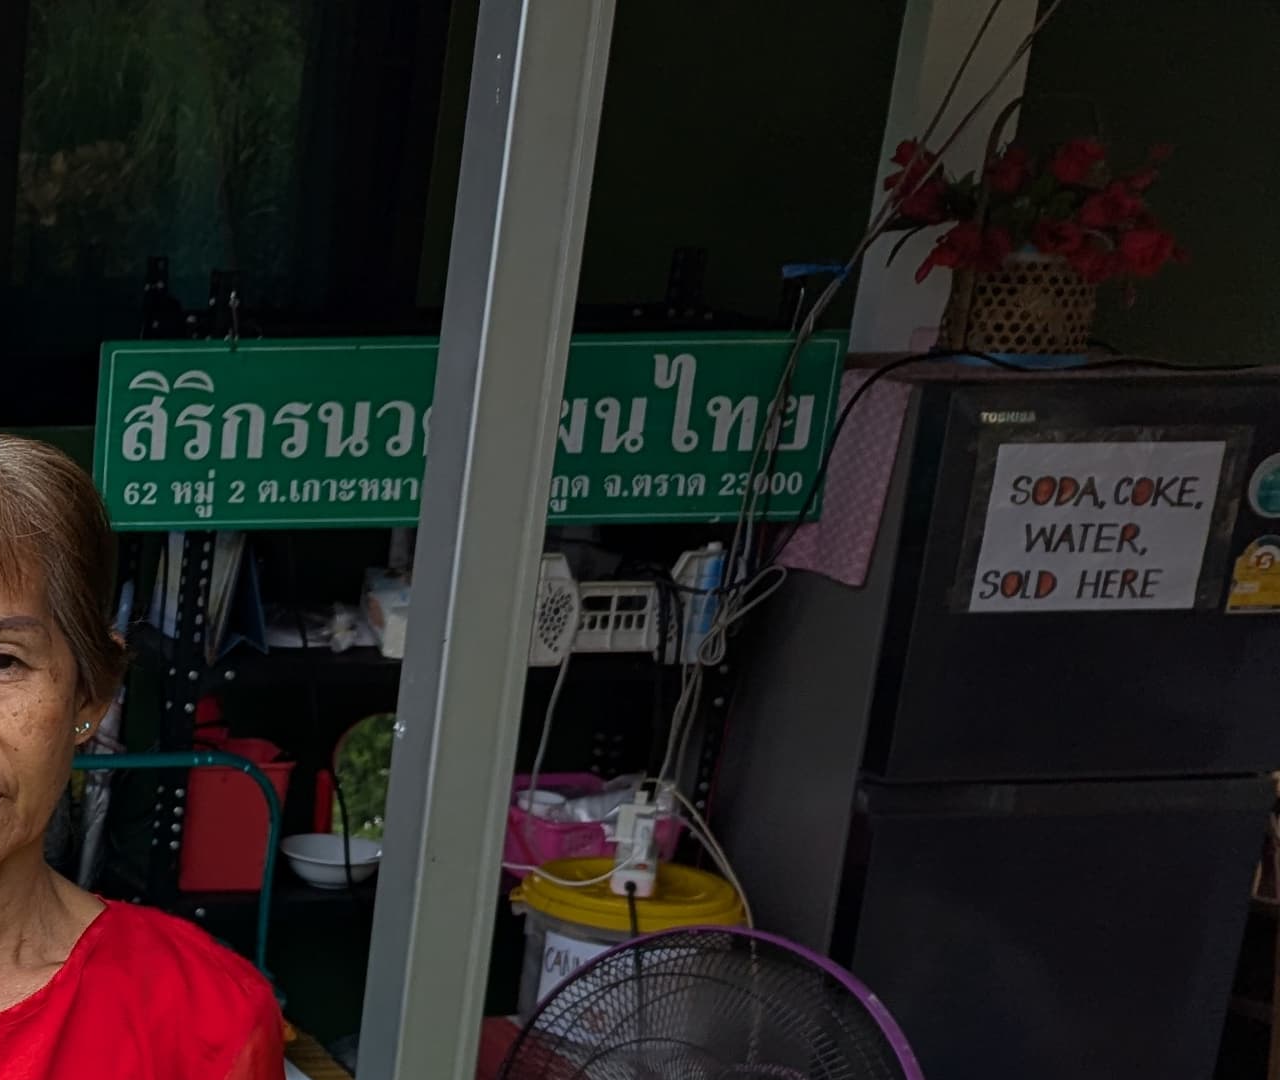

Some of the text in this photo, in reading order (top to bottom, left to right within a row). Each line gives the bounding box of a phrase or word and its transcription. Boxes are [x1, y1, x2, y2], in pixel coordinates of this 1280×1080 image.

[979, 410, 1037, 424] TOSHIBA
[123, 481, 158, 505] 62
[170, 469, 216, 519] หมู่
[227, 480, 247, 504] 2
[257, 475, 422, 504] ต.เกาะหมา
[603, 471, 707, 499] จ.ตราด
[1025, 522, 1149, 556] WATER,
[979, 568, 1163, 600] SOLD HERE
